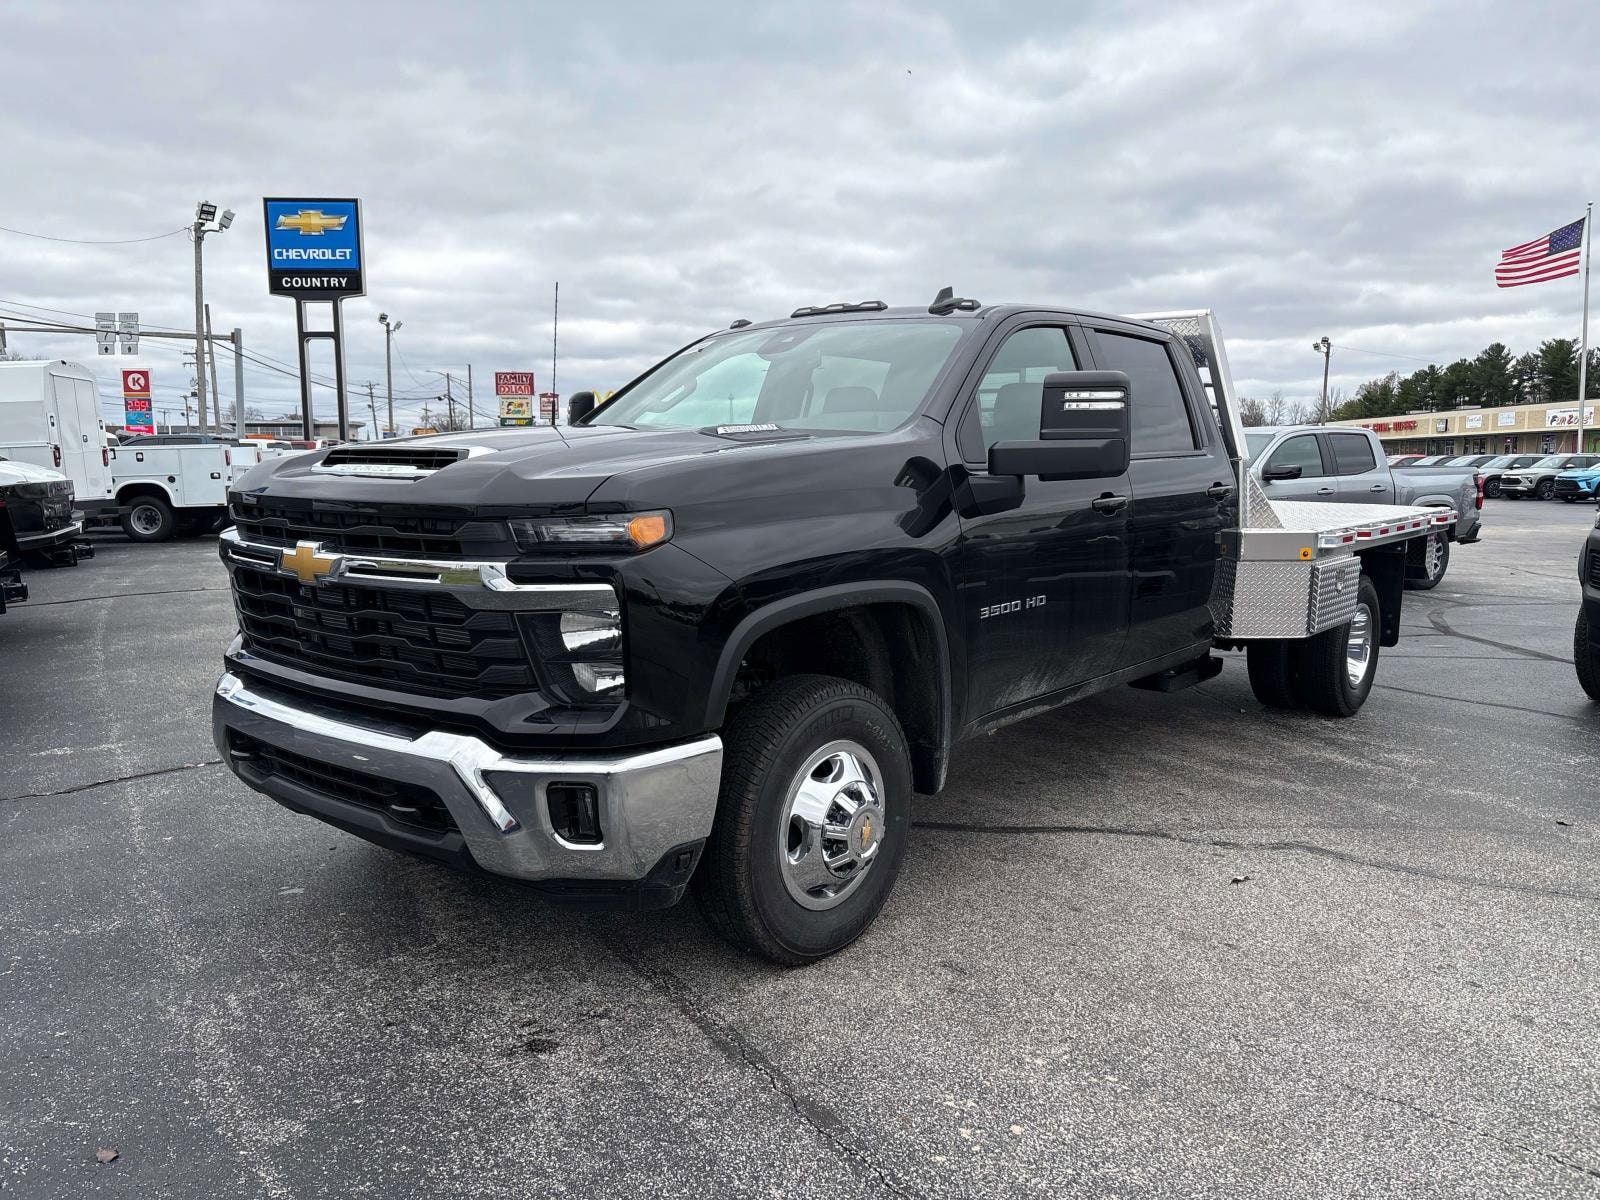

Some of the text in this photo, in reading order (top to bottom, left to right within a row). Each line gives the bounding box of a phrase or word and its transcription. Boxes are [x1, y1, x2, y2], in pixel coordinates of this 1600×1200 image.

[273, 248, 352, 260] CHEVROLET
[282, 277, 348, 288] COUNTRY
[497, 373, 531, 384] FAMILY
[980, 595, 1046, 619] 3500 HD
